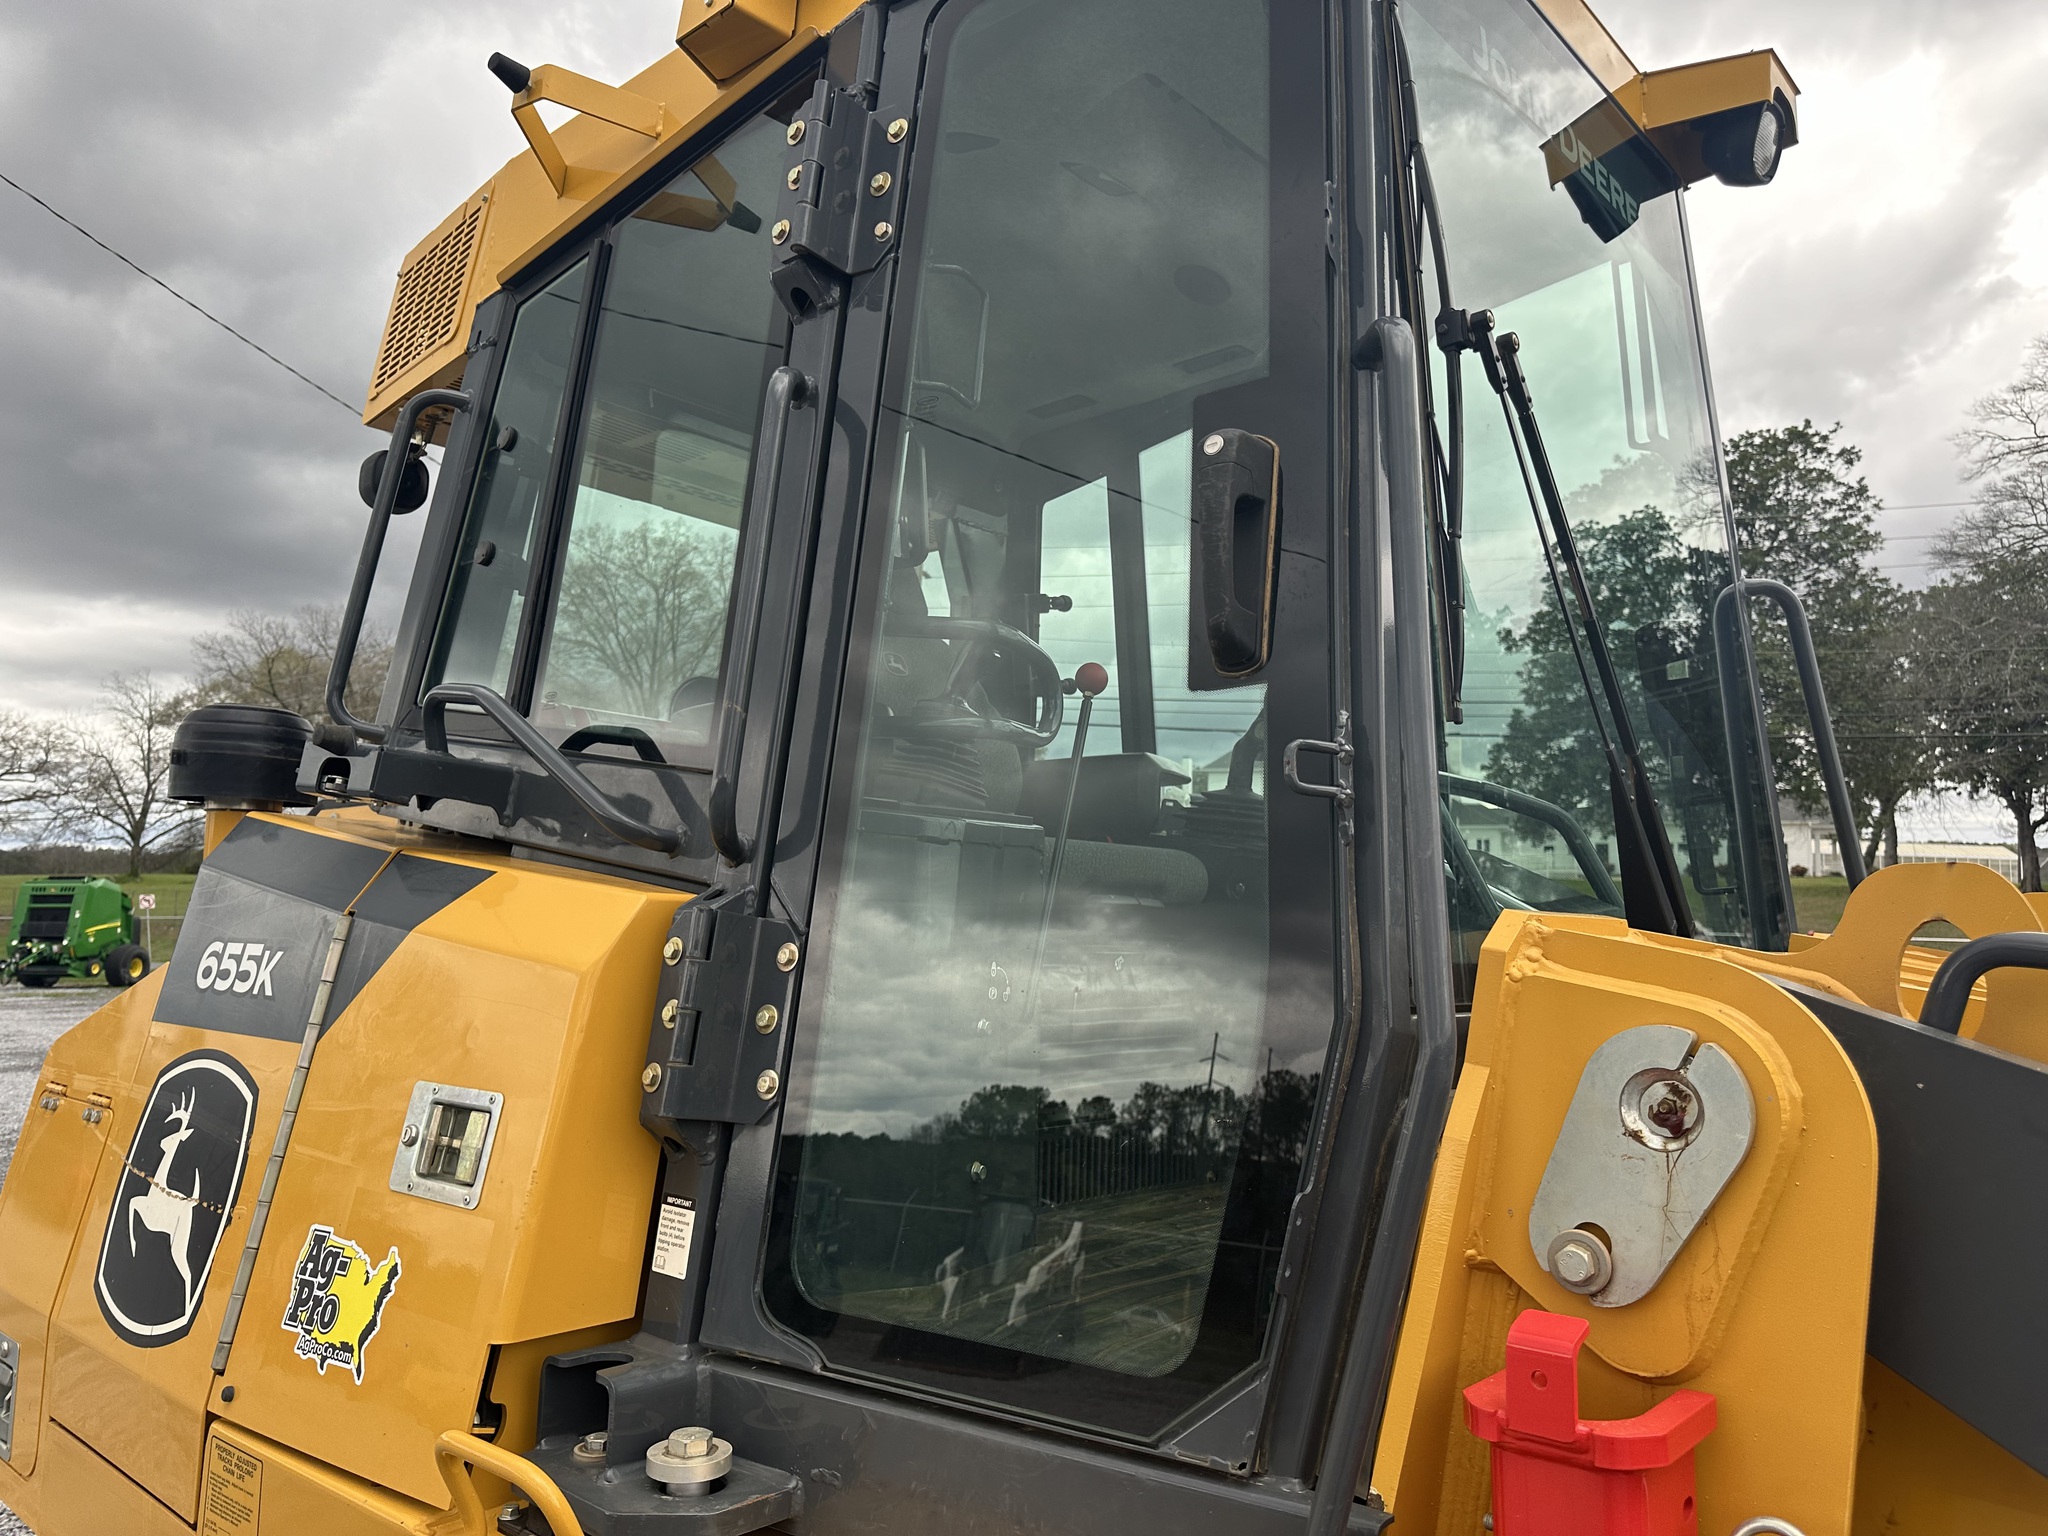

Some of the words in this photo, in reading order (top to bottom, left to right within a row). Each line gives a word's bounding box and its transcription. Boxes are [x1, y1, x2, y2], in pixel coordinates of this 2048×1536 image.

[196, 940, 284, 997] 655K
[667, 1196, 693, 1208] IMPORTANT
[661, 1215, 676, 1224] damage,
[676, 1219, 690, 1227] remove
[673, 1209, 687, 1218] isolator
[670, 1240, 686, 1249] operator
[674, 1233, 685, 1241] before
[299, 1229, 352, 1291] Ag-
[284, 1278, 340, 1334] Pro
[298, 1335, 352, 1364] AgProCo.com
[216, 1443, 235, 1460] PROPERLY
[236, 1455, 257, 1471] ADJUSTED
[217, 1453, 233, 1467] TRACKS
[234, 1463, 254, 1478] PROLONG
[223, 1465, 235, 1477] CHAIN
[236, 1472, 245, 1483] LIFE
